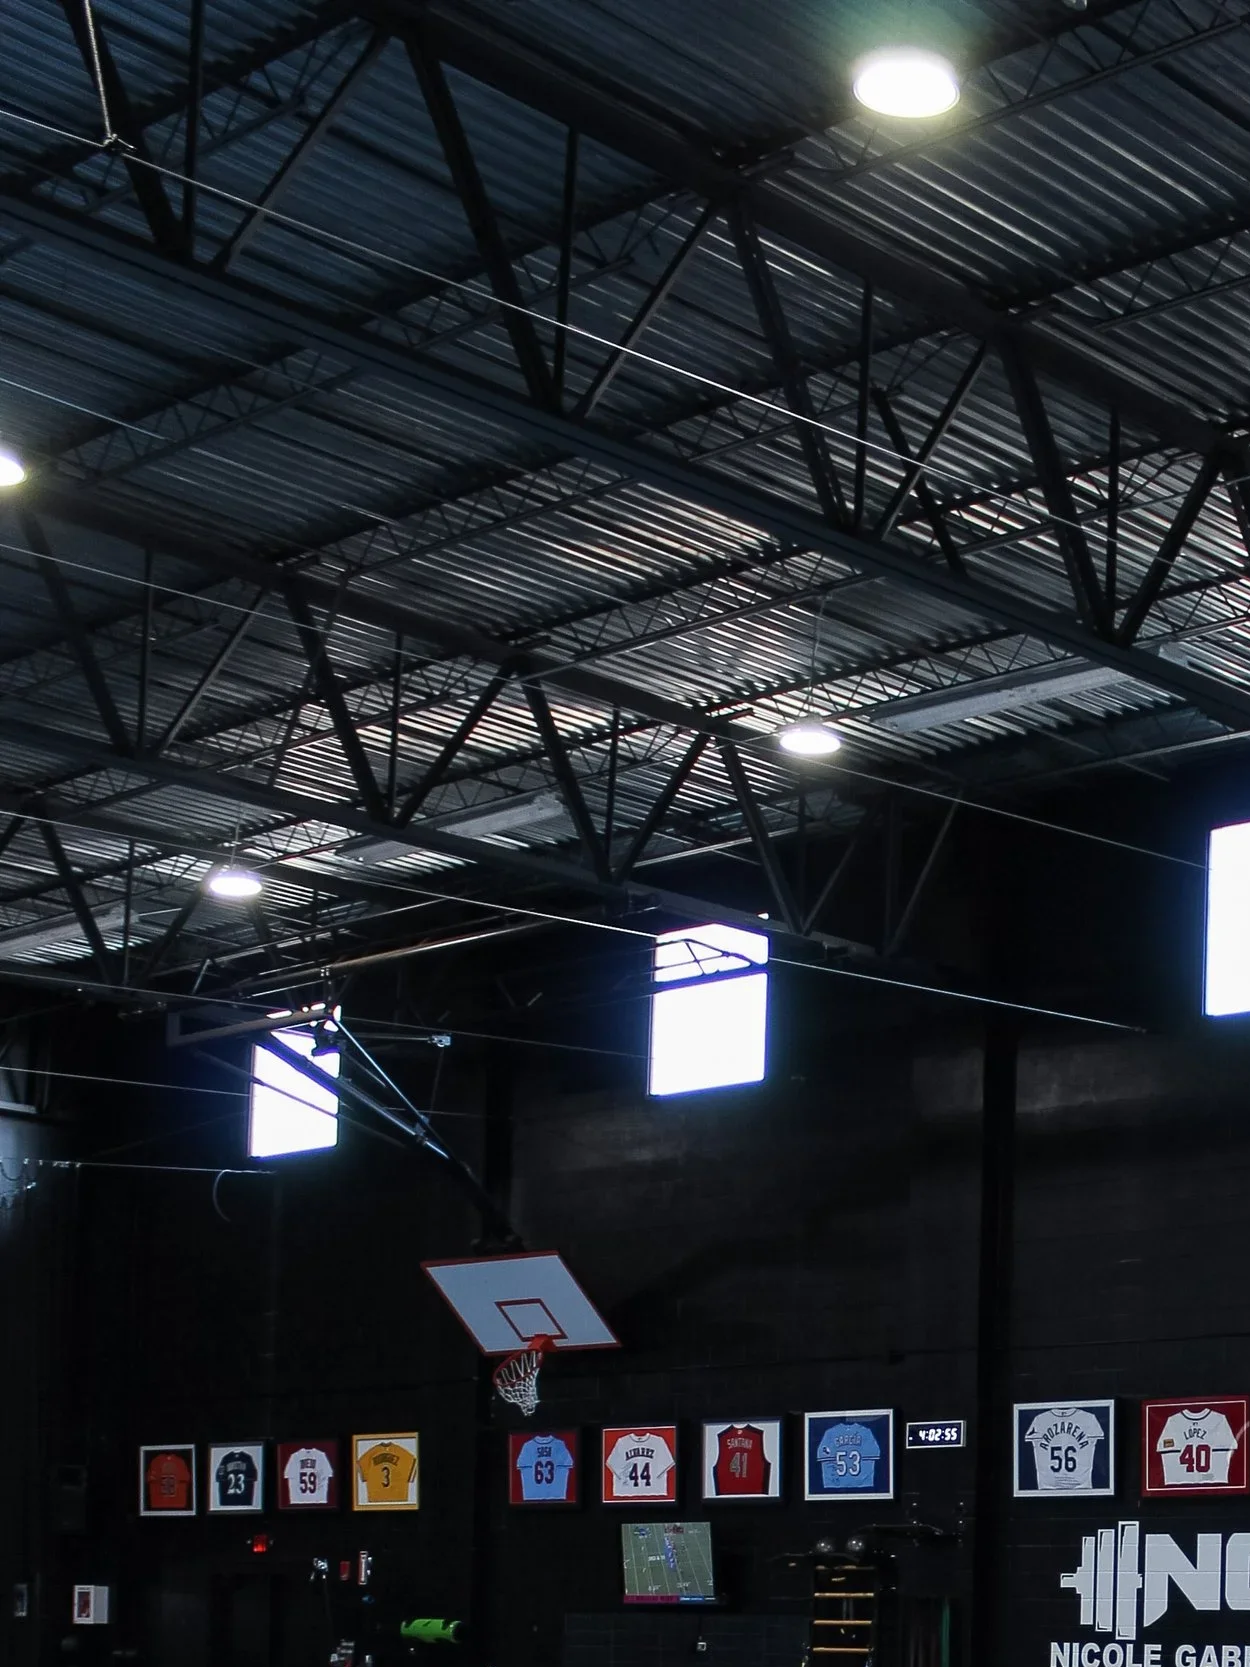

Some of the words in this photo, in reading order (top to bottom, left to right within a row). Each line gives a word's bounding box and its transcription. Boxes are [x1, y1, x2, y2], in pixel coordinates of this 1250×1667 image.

[727, 1437, 753, 1449] SANTANA
[918, 1428, 958, 1442] 4:02:55
[1039, 1421, 1089, 1450] AROZARENA
[1183, 1425, 1207, 1440] LÓPEZ
[537, 1446, 552, 1458] SOSA
[625, 1447, 655, 1461] ALVAREZ
[836, 1450, 861, 1476] 53
[1050, 1446, 1077, 1472] 56
[1179, 1444, 1211, 1472] 40
[534, 1461, 555, 1485] 63
[629, 1462, 651, 1487] 44
[730, 1452, 748, 1478] 41
[227, 1473, 245, 1494] 23
[299, 1472, 317, 1494] 59
[381, 1466, 391, 1488] 3
